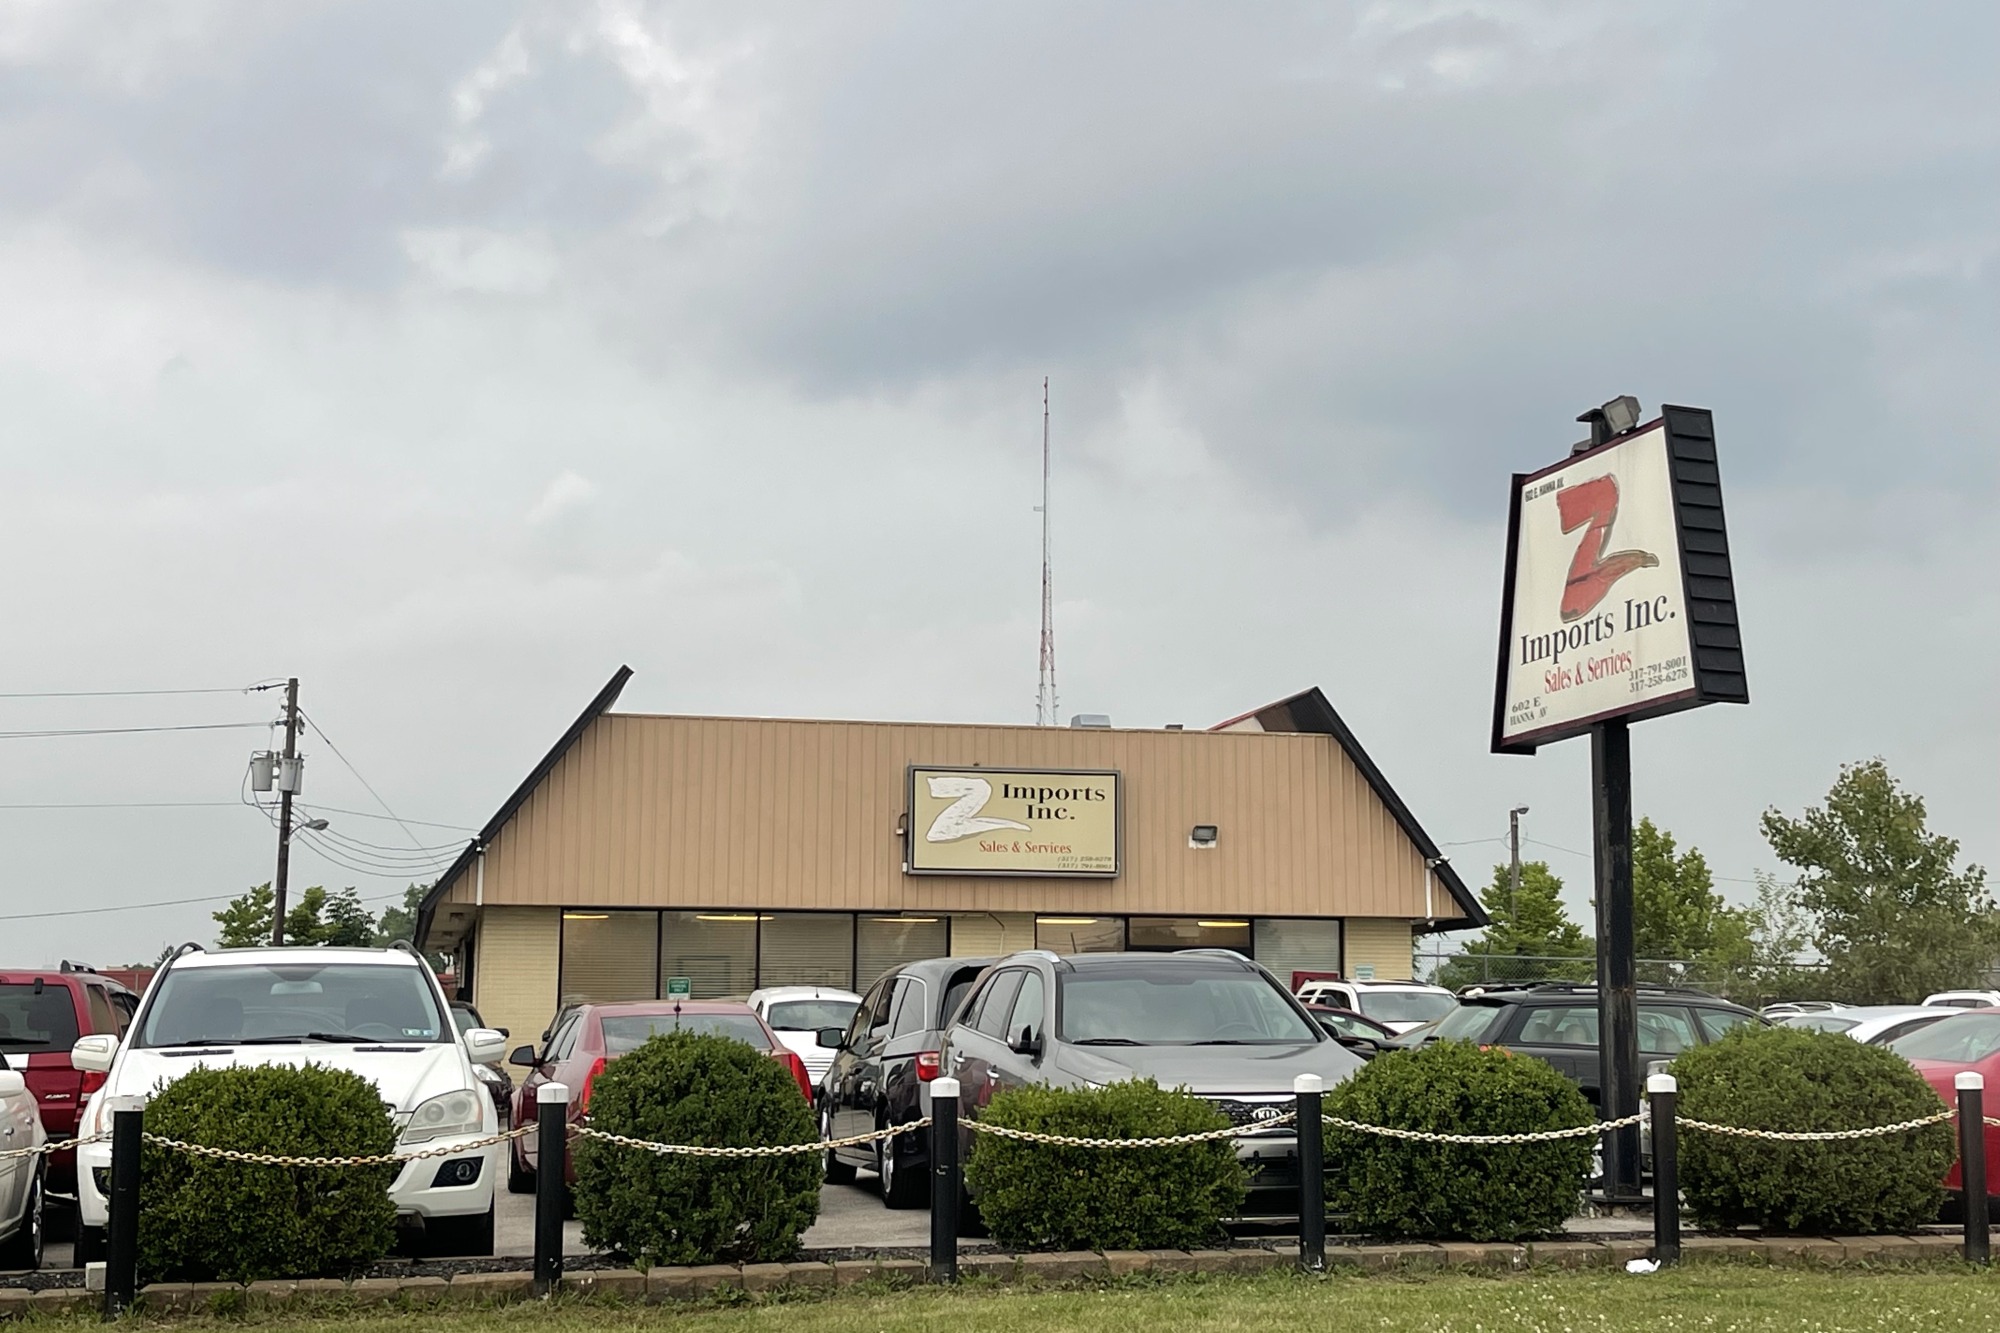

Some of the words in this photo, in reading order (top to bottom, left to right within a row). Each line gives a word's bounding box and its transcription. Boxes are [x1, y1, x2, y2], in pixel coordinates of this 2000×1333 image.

[1521, 612, 1614, 665] Imports
[1624, 595, 1675, 633] Inc.
[1545, 666, 1572, 694] Sales
[1575, 662, 1584, 686] &
[1587, 648, 1632, 682] Services
[1629, 656, 1686, 681] 317-791-8001
[1629, 667, 1688, 693] 317-258-6278
[1512, 699, 1530, 713] 602
[1533, 696, 1541, 707] E
[1510, 710, 1535, 726] HANNA
[1002, 783, 1106, 804] Imports
[1026, 804, 1075, 820] Inc.
[979, 840, 1008, 853] Sales
[1011, 841, 1021, 853] &
[1025, 841, 1072, 854] Services
